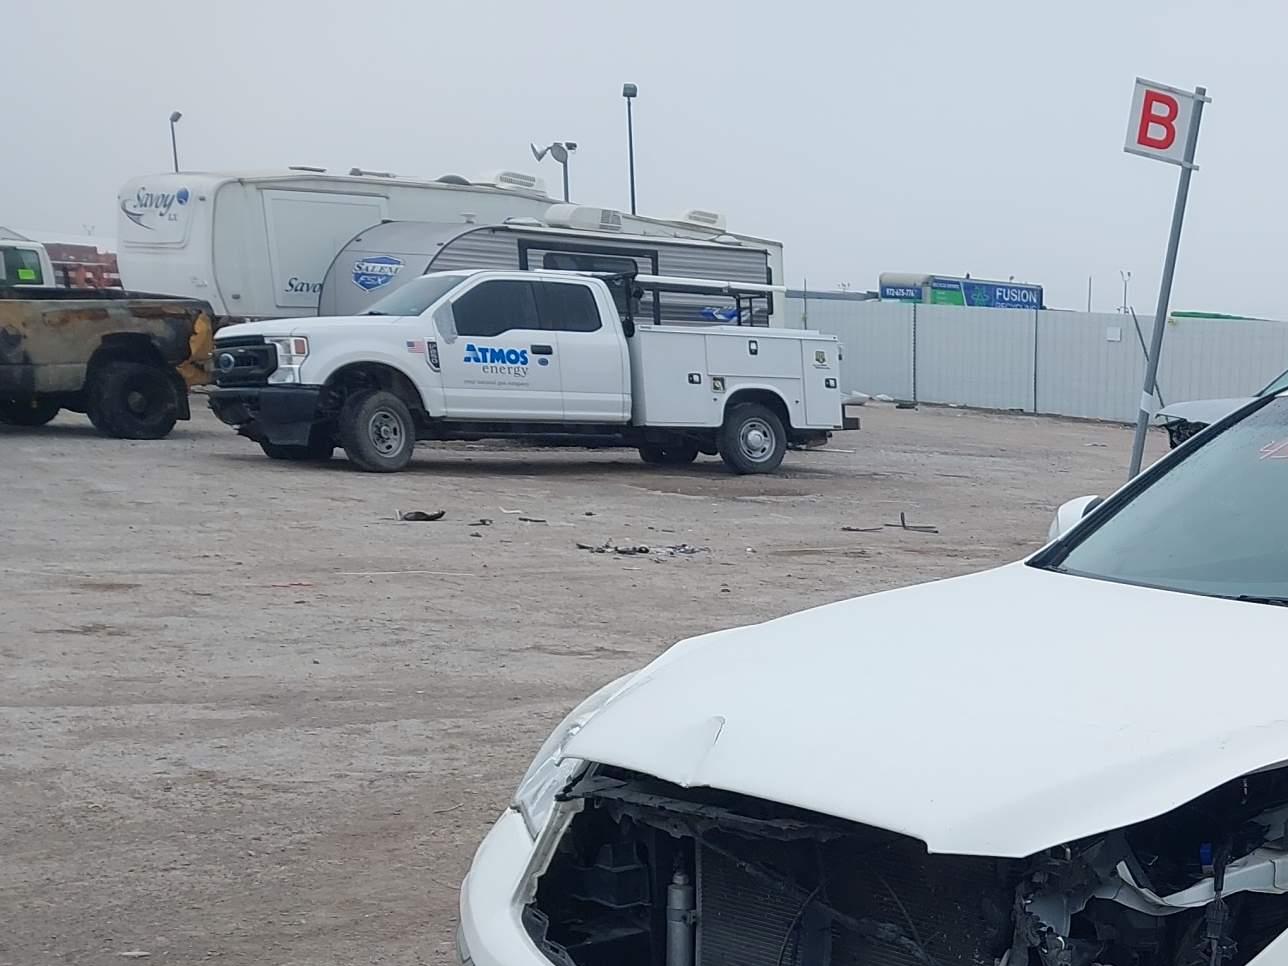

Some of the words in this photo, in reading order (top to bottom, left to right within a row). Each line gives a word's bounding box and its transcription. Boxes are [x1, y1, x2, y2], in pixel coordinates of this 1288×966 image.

[1137, 89, 1179, 149] B
[133, 186, 175, 216] Savoy
[354, 263, 402, 274] SALEM
[285, 277, 322, 292] Savo
[995, 287, 1037, 303] FUSION
[464, 344, 528, 365] ATMOS
[482, 363, 528, 378] energy
